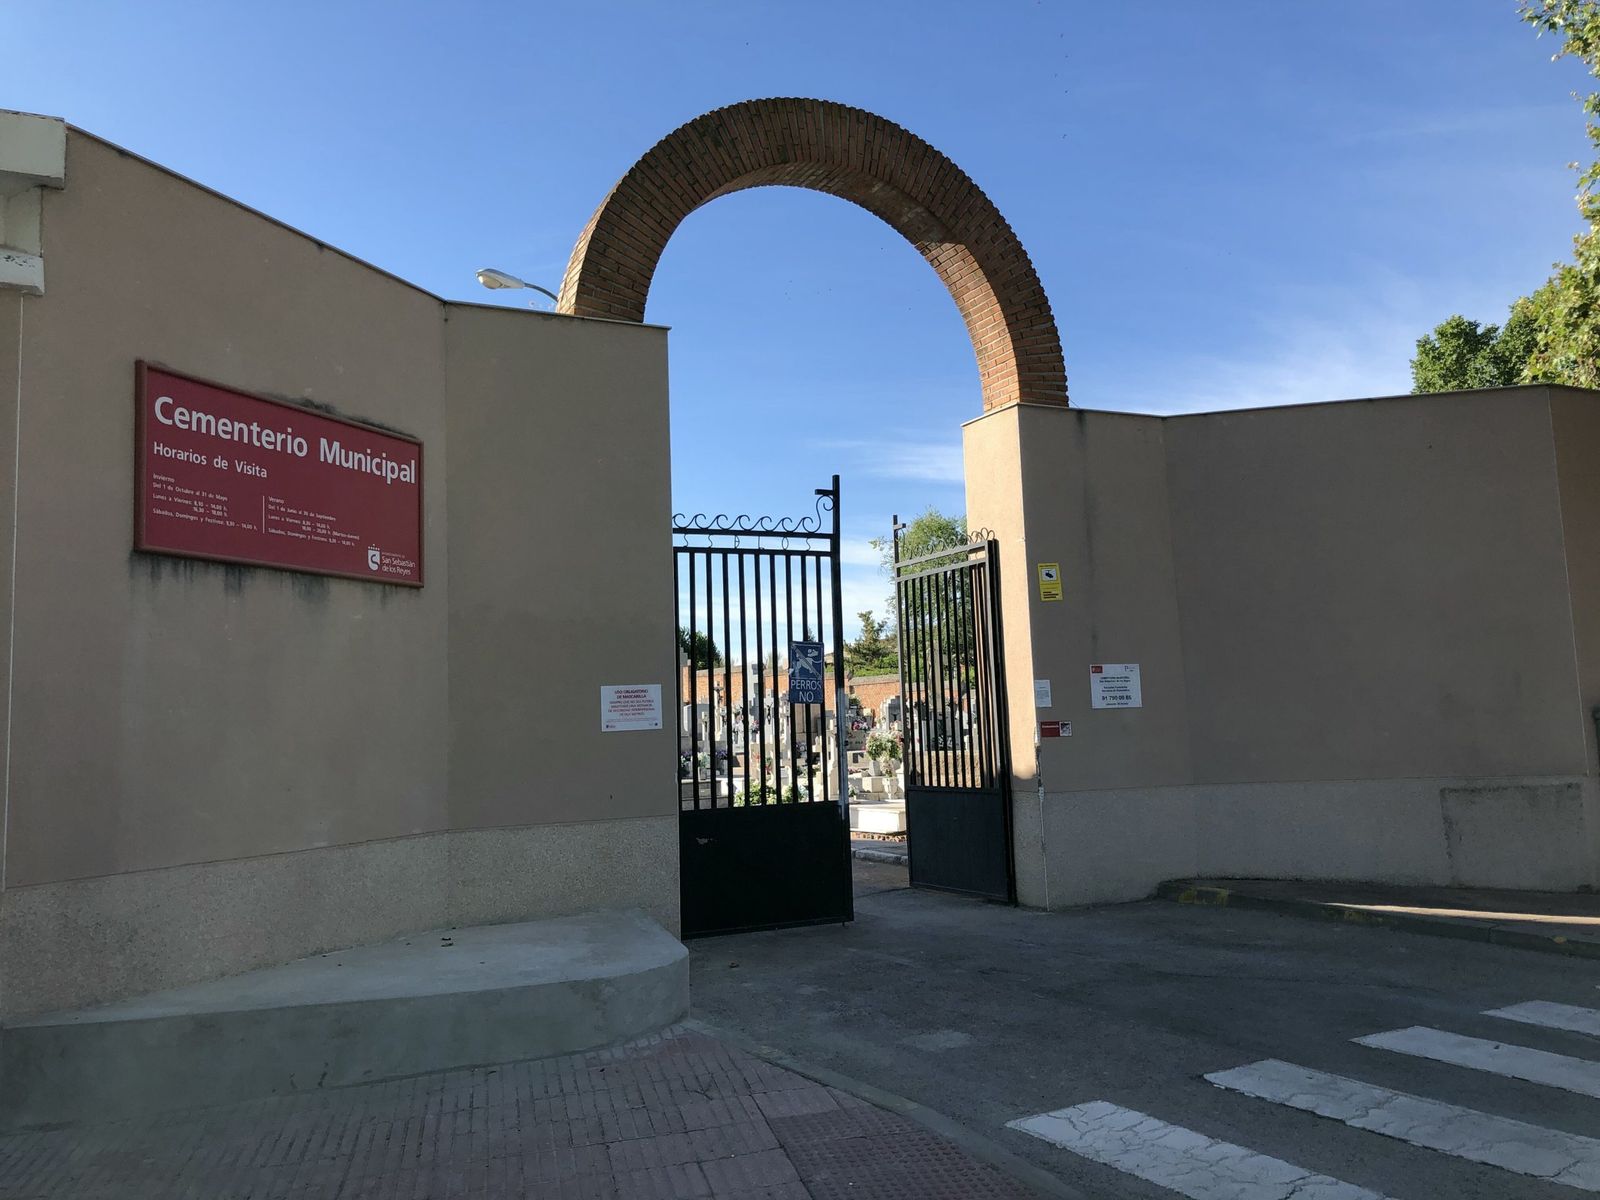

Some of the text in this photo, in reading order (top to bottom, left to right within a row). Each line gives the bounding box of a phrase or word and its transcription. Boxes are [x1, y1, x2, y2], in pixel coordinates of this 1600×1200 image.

[154, 396, 416, 484] Cementerio Municipal
[154, 441, 268, 478] Horarios de Visita
[153, 473, 174, 483] Invierno
[176, 512, 198, 521] Domingos
[382, 556, 391, 564] San
[791, 680, 822, 690] PERROS
[800, 691, 814, 702] NO
